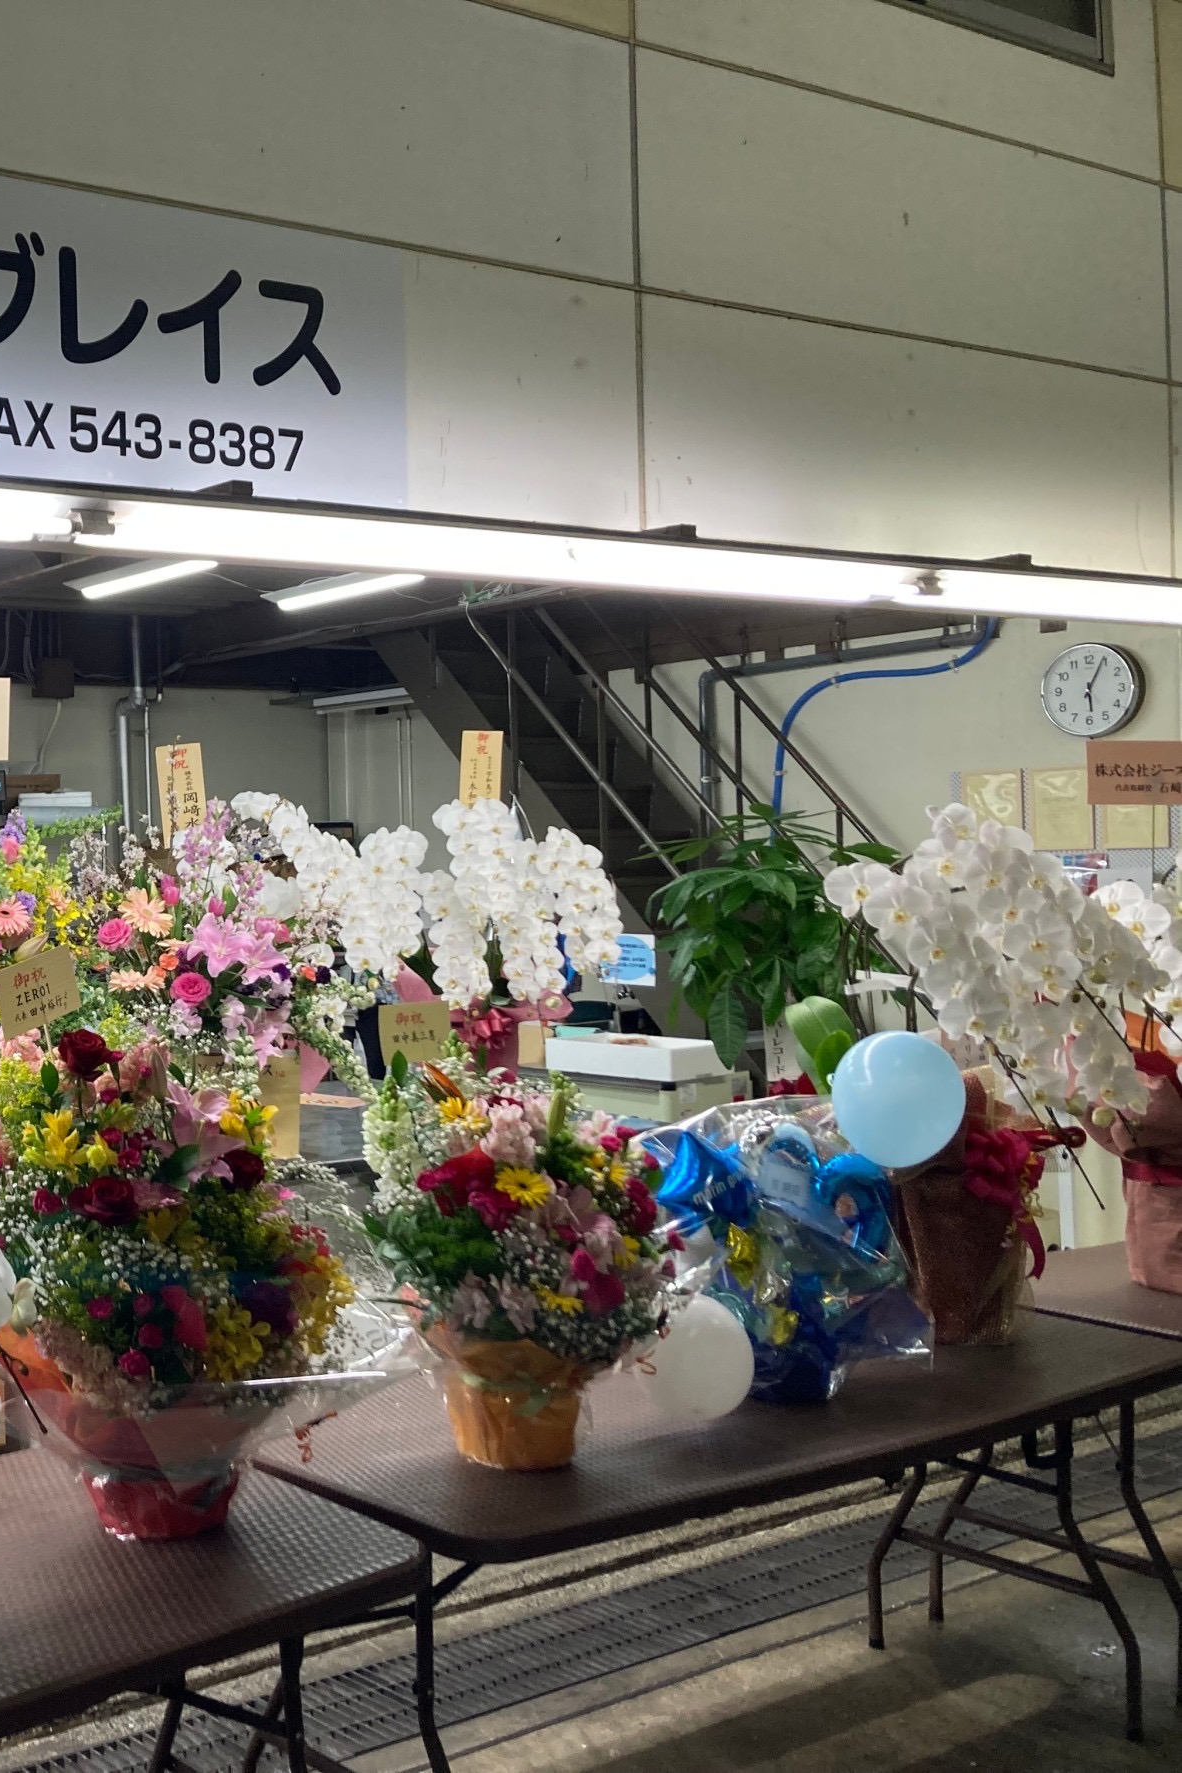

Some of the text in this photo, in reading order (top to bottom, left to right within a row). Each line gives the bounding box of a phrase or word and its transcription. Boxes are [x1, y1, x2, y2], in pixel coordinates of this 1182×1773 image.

[69, 406, 304, 472] 543-8387
[1070, 660, 1078, 670] 11
[1084, 655, 1095, 665] 12
[1114, 667, 1121, 676] 2
[1058, 672, 1069, 682] 10
[1055, 687, 1062, 697] 9
[1118, 683, 1126, 692] 3
[1059, 703, 1066, 712] 8
[1113, 698, 1120, 708] 4
[1071, 713, 1078, 723] 7
[1086, 716, 1093, 725] 6
[1102, 711, 1109, 720] 5
